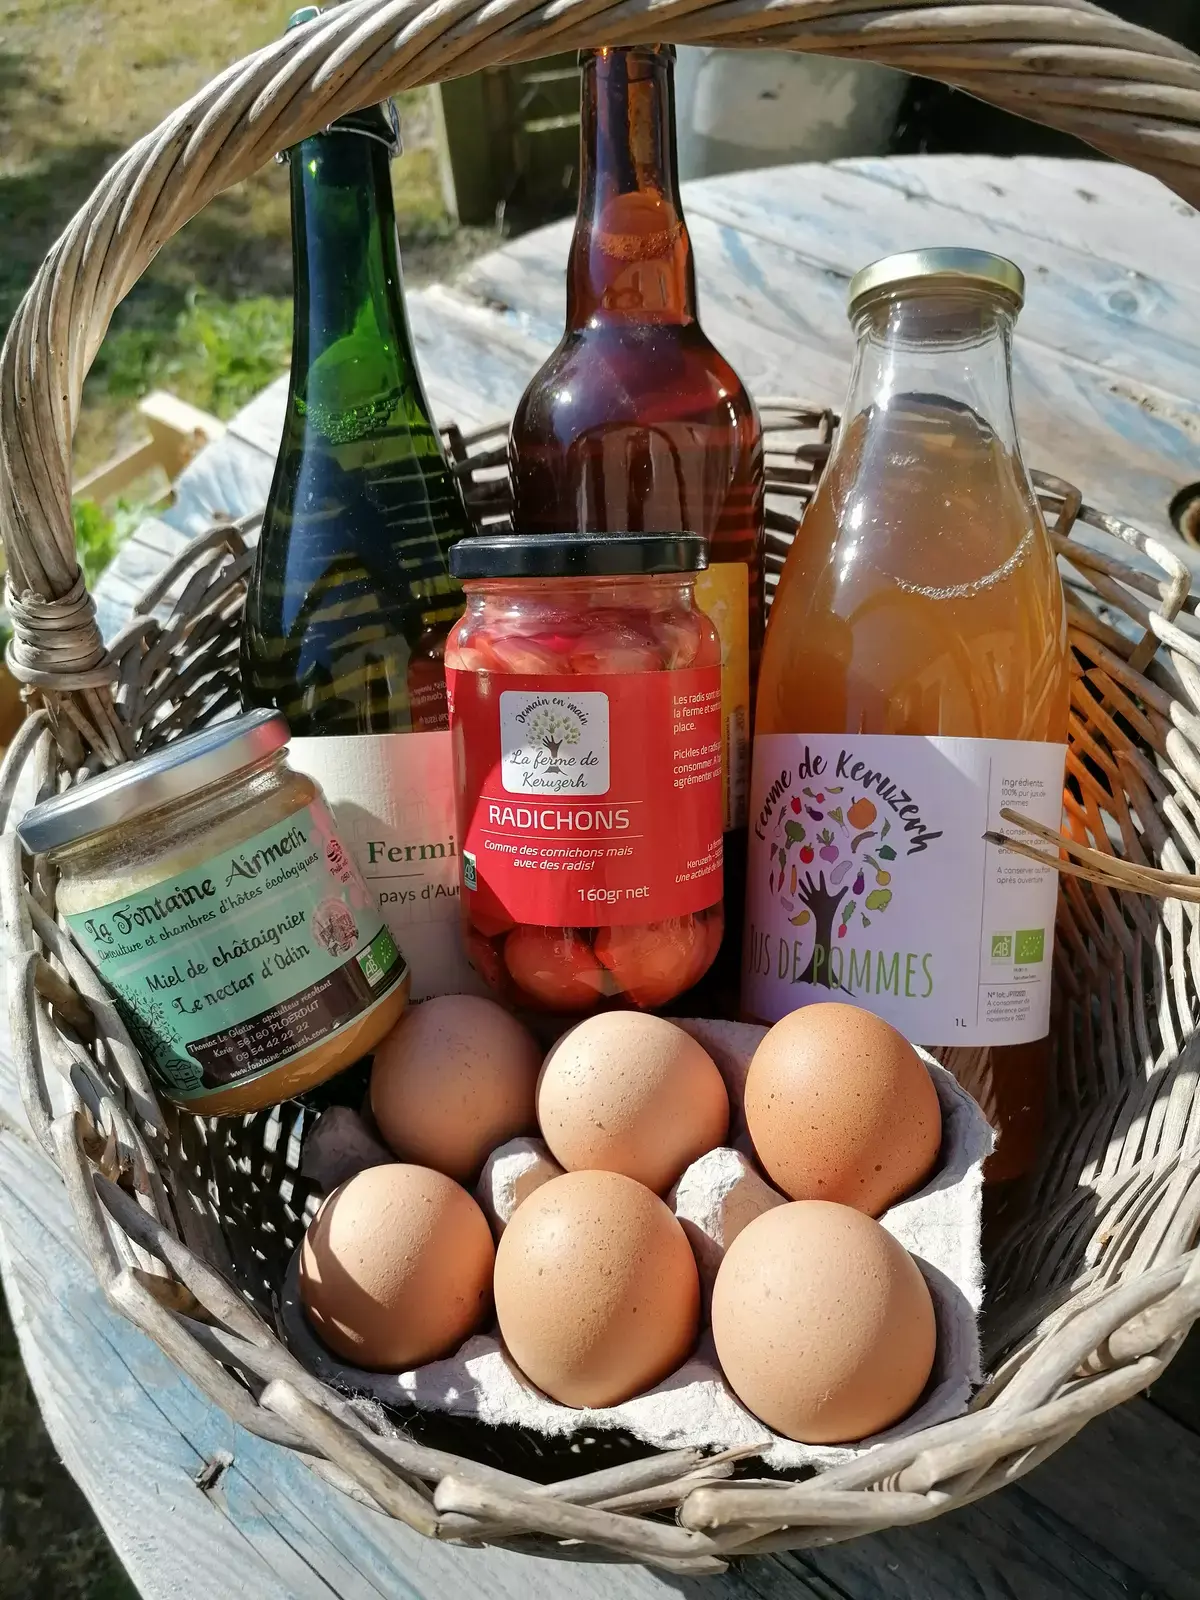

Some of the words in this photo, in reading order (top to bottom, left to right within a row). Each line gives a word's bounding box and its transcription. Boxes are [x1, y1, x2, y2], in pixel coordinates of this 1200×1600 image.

[673, 695, 687, 706] Les
[689, 691, 705, 704] radis
[515, 696, 550, 724] Demain
[552, 697, 565, 707] en
[567, 701, 589, 726] main
[673, 708, 681, 719] la
[682, 706, 703, 717] ferme
[673, 722, 696, 736] place.
[510, 749, 531, 766] La
[534, 750, 577, 769] ferme
[580, 750, 600, 766] de
[673, 747, 700, 760] Pickles
[700, 744, 708, 755] de
[522, 771, 588, 793] Keruzerh
[673, 771, 712, 789] agrémenter
[754, 770, 793, 841] Ferme
[798, 745, 828, 781] de
[835, 749, 943, 857] Keruzerh
[1000, 799, 1029, 808] pommes
[488, 804, 631, 831] RADICHONS
[484, 838, 517, 854] Comme
[519, 844, 538, 856] des
[540, 845, 604, 858] cornichons
[606, 845, 634, 857] mais
[513, 858, 537, 869] avec
[539, 858, 560, 870] des
[562, 860, 595, 871] radis!
[84, 918, 114, 945] La
[112, 878, 217, 936] Fontaine
[225, 826, 308, 888] Airmeth
[675, 873, 690, 883] Une
[145, 934, 158, 947] et
[159, 910, 217, 942] chambres
[219, 886, 263, 914] d'hôtes
[265, 852, 319, 890] écologiques
[379, 888, 416, 906] pays
[577, 888, 623, 904] 160gr
[625, 885, 649, 899] net
[145, 966, 186, 994] Miel
[187, 959, 208, 980] de
[212, 910, 307, 968] châtaignier
[748, 923, 771, 976] JUS
[776, 938, 803, 984] DE
[812, 942, 934, 998] POMMES
[171, 996, 204, 1016] Le
[204, 972, 255, 1007] nectar
[187, 1038, 218, 1054] Thomas
[218, 1033, 228, 1044] Le
[262, 1000, 300, 1025] apiculteur
[301, 979, 332, 1003] récoltant
[236, 1052, 249, 1063] 09
[251, 1045, 265, 1057] 54
[266, 1037, 281, 1049] 42
[281, 1029, 295, 1041] 22
[296, 1021, 310, 1033] 22
